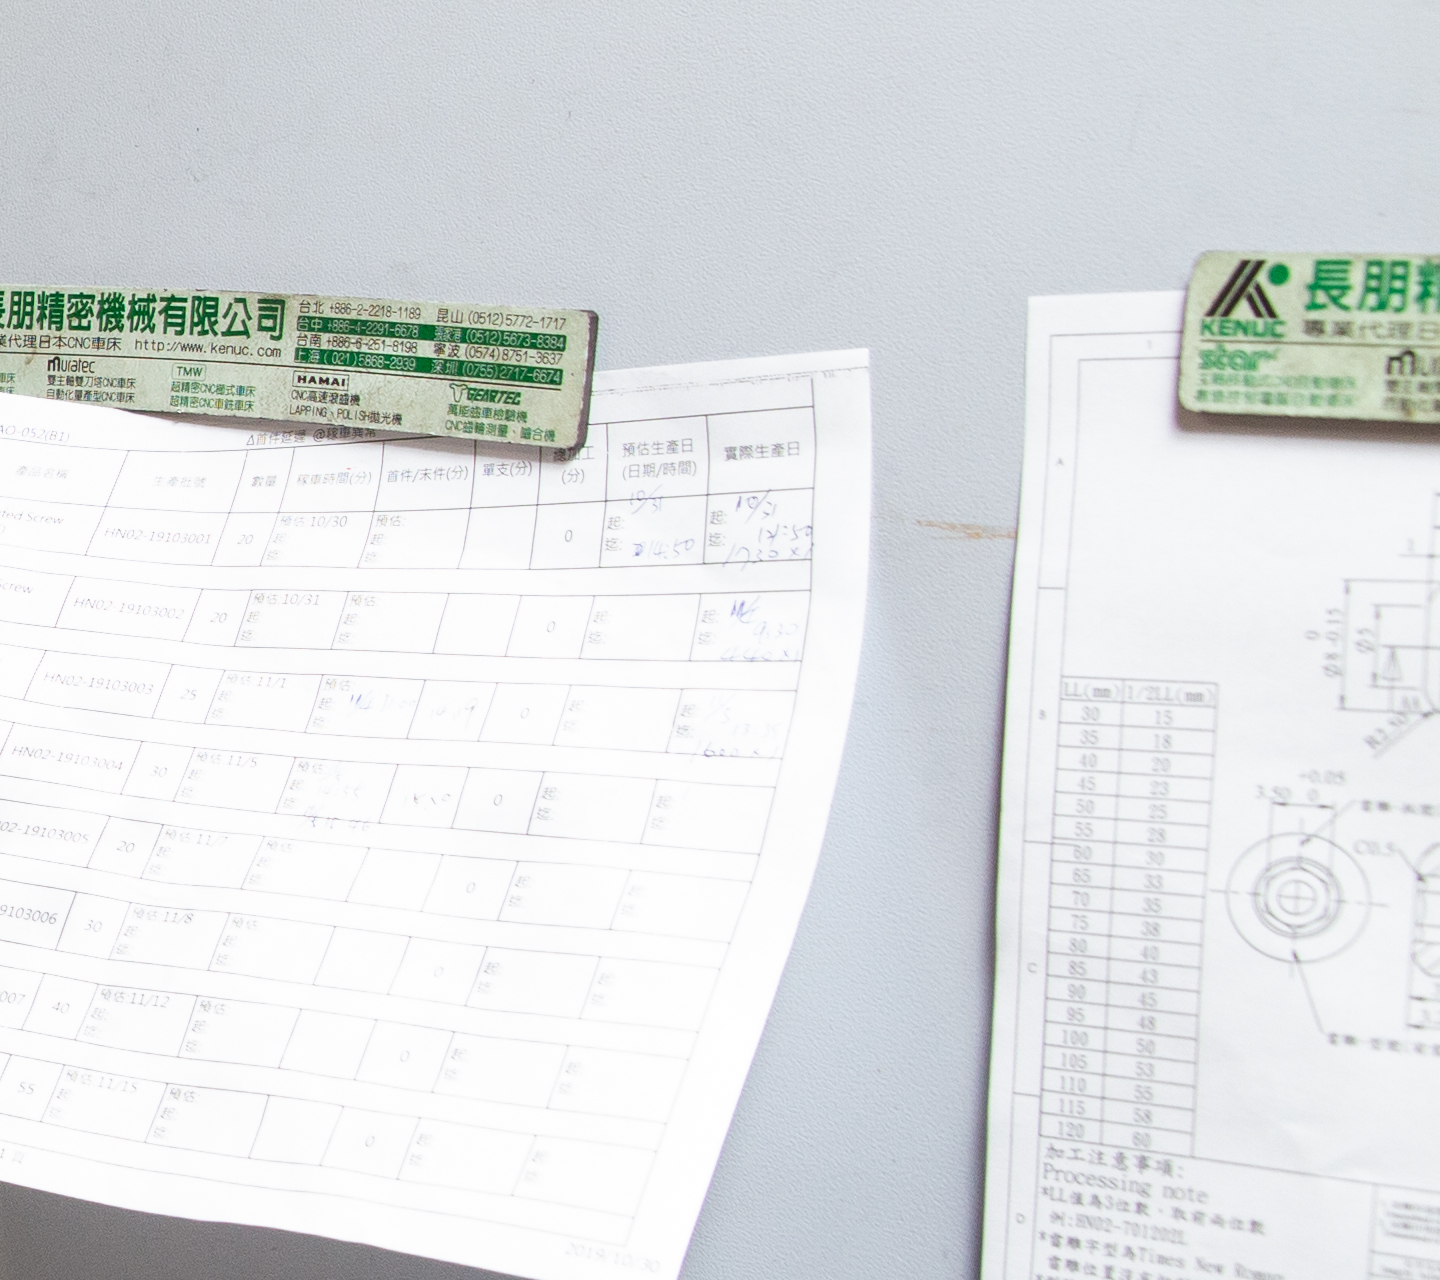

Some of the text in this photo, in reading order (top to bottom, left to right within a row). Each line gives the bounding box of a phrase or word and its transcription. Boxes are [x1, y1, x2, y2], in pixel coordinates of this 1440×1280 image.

[298, 300, 566, 330] 台北 +886-2-2218-1189 昆山 (0512)5772-1717
[296, 318, 323, 332] 台中
[327, 320, 419, 338] +886-4-2291-6678
[466, 328, 565, 349] (0512)5673-8384
[1200, 320, 1286, 339] KENUC
[296, 333, 322, 348] 台南
[326, 336, 418, 355] +886-6-251-8198
[464, 344, 563, 365] (0574)8751-3637
[1198, 343, 1278, 370] star
[177, 366, 203, 378] TMW
[295, 349, 320, 363] 上海
[431, 360, 459, 375] 深圳
[462, 361, 562, 383] (0755)2717-6674
[297, 375, 346, 387] HAMAI
[621, 437, 694, 458] 預估生產日
[723, 441, 801, 463] 實際生產日
[26, 510, 65, 525] Screw
[104, 527, 212, 546] HN02-19103001
[236, 533, 255, 546] 20
[73, 596, 185, 620] HN02-19103002
[209, 611, 228, 624] 20
[43, 671, 155, 696] HN02-19103003
[179, 688, 198, 702] 25
[11, 745, 124, 772] HN02-19103004
[149, 764, 168, 779] 30
[116, 840, 136, 854] 20
[83, 919, 104, 934] 30
[51, 1000, 71, 1015] 40
[17, 1080, 35, 1096] 55
[1043, 1162, 1210, 1205] Processing note
